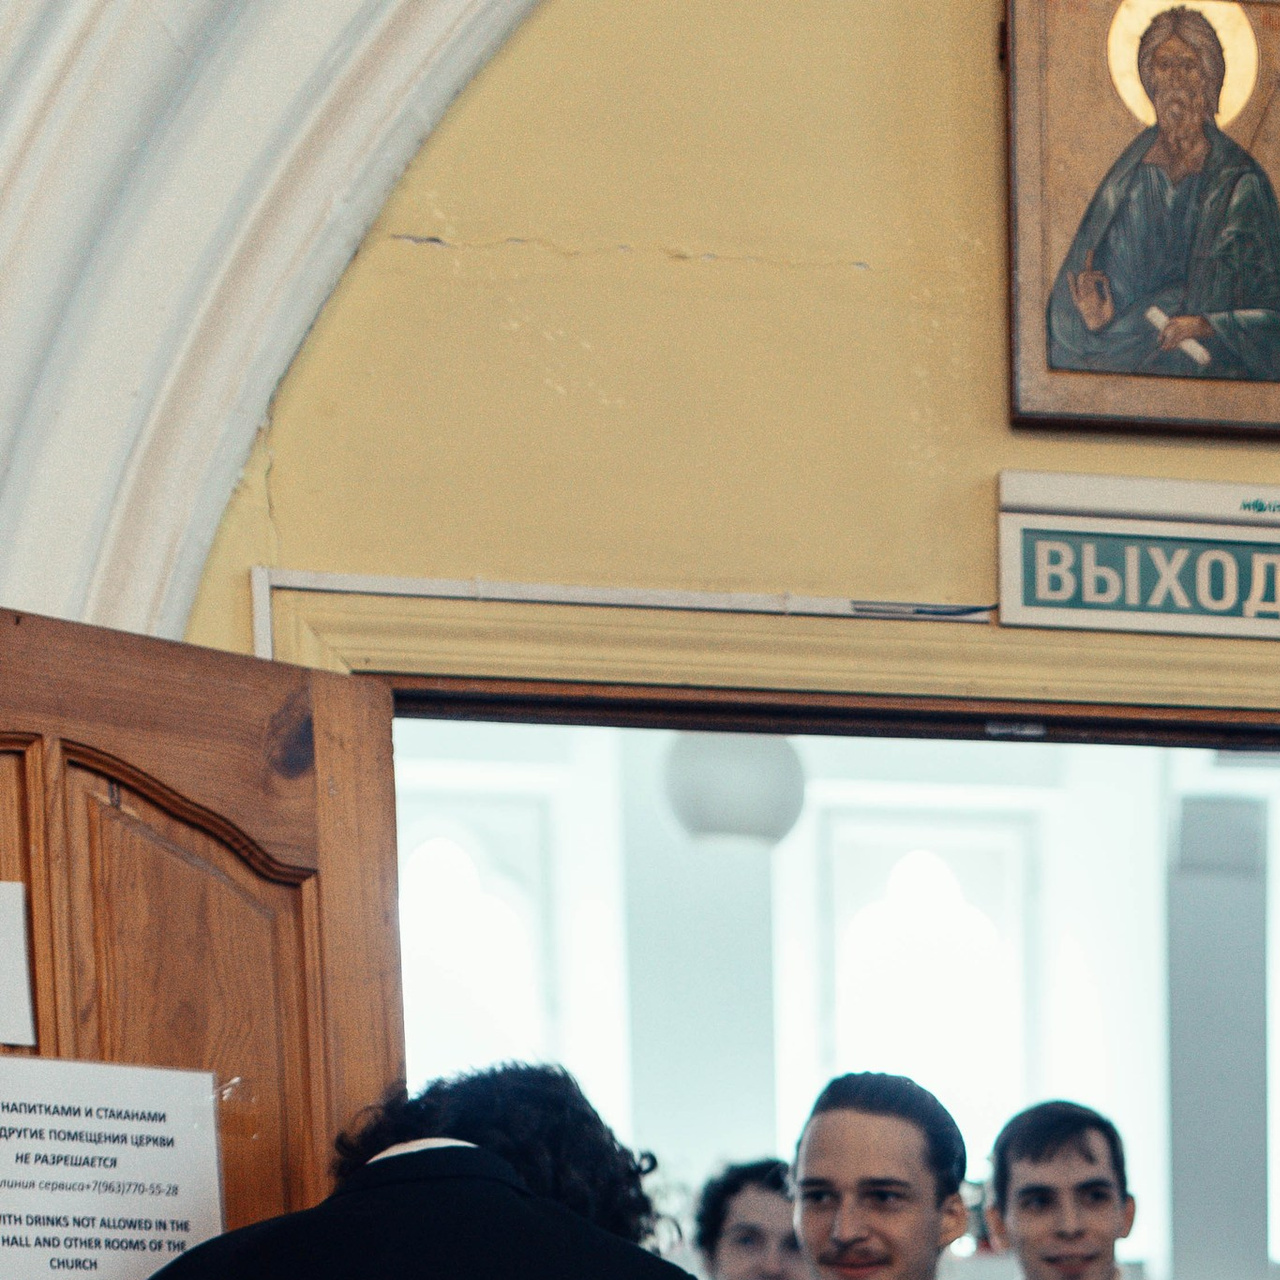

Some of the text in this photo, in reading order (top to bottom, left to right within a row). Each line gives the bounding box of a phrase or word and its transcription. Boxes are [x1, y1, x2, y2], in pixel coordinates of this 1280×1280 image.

[1, 1101, 167, 1123] НАПИТКАМИ И СТАКАНАМИ
[0, 1126, 175, 1148] ДРУГИЕ ПОМЕЩЕНИЯ ЦЕРКВИ
[15, 1152, 117, 1169] НЕ РАЗРЕШАЕТСЯ
[0, 1213, 190, 1233] ITH DRINKS NOT ALLOWED IN THE
[1, 1235, 186, 1252] HALL AND OTHER ROOMS OF THE
[49, 1257, 98, 1271] CHURCH
